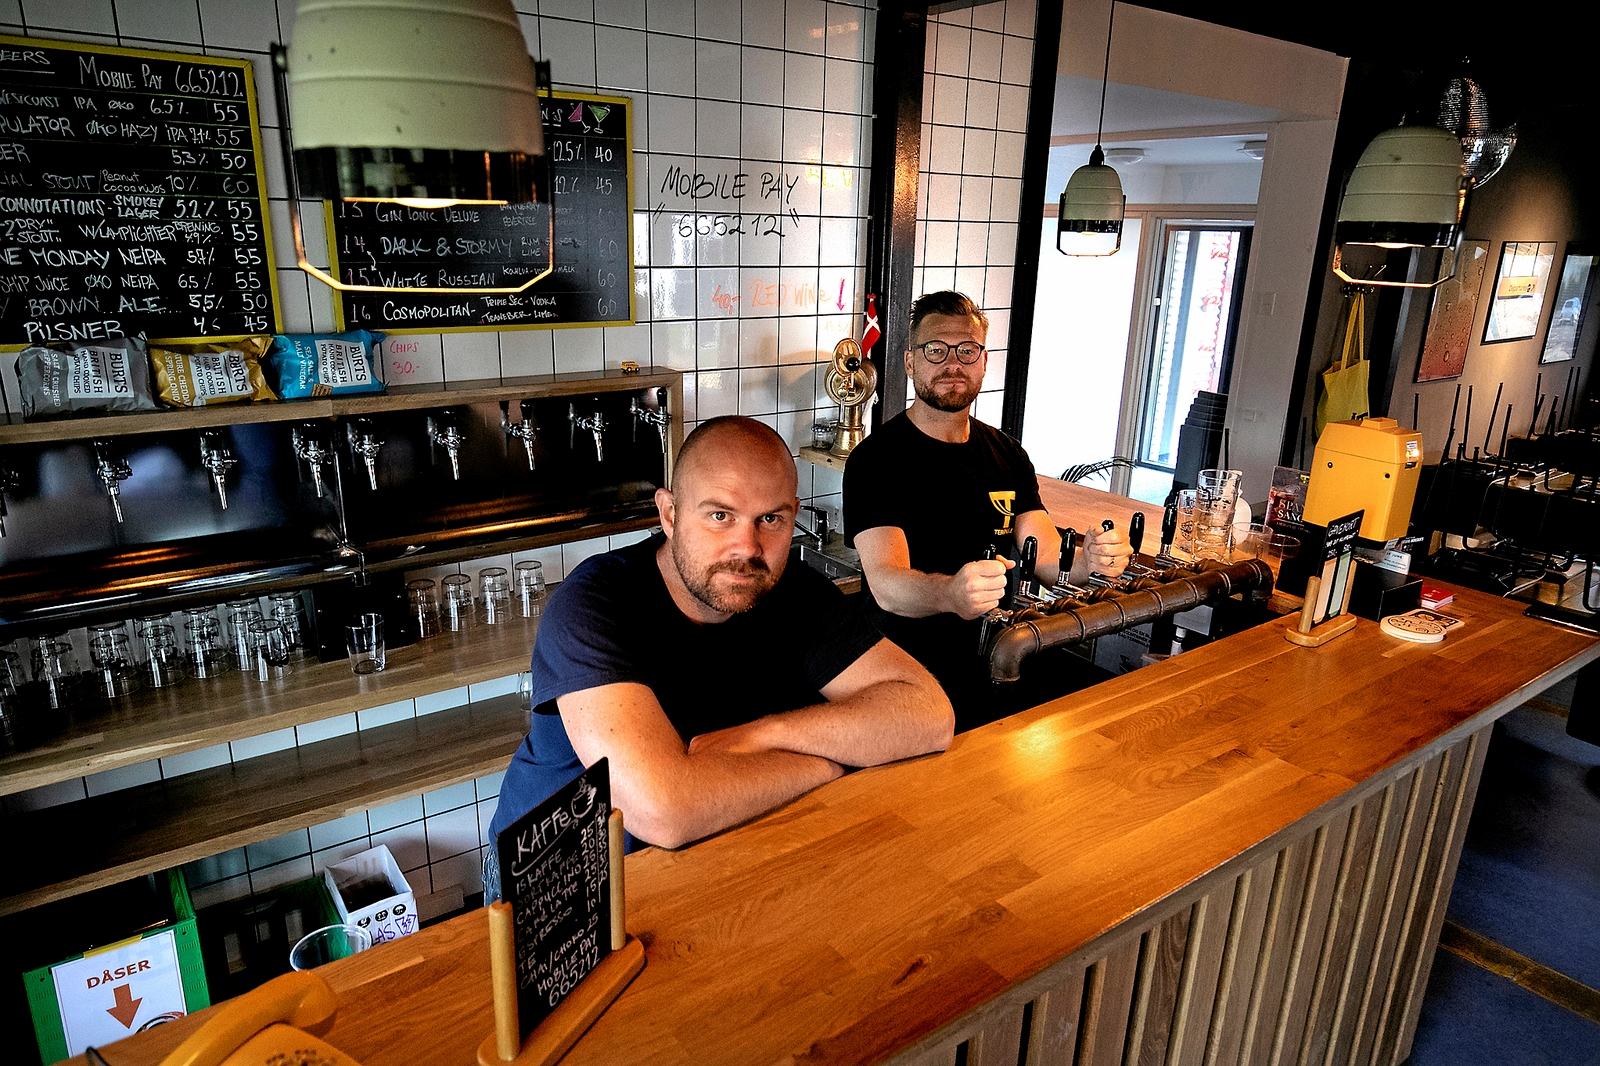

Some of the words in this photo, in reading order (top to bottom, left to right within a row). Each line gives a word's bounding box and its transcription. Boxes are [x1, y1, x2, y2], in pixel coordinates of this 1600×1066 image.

[0, 49, 51, 66] EERS
[174, 65, 244, 98] 665212
[73, 96, 98, 111] IPA
[213, 103, 239, 122] 55
[120, 122, 158, 143] HAZY
[216, 128, 246, 146] 55
[221, 152, 248, 170] 50
[594, 146, 613, 163] 40
[42, 171, 96, 191] STOUT
[223, 176, 251, 195] 60
[595, 176, 613, 196] 45
[660, 164, 749, 201] MOBILE
[760, 172, 800, 205] PAY
[112, 194, 166, 208] SMOKEY
[227, 200, 253, 220] 55
[117, 206, 160, 220] LAGER
[231, 222, 259, 243] 55
[342, 234, 366, 255] 14
[380, 235, 432, 258] DARK
[436, 236, 452, 257] &
[455, 236, 513, 258] STORMY
[28, 247, 110, 270] MONDAY
[234, 247, 262, 266] 55
[235, 271, 262, 290] 55
[345, 267, 371, 287] 15
[378, 270, 430, 289] WHITE
[437, 267, 496, 287] RUSSIAN
[242, 293, 268, 312] 50
[529, 295, 557, 307] VODKA
[749, 279, 788, 308] RED
[28, 296, 103, 318] BROWN
[350, 303, 371, 324] 16
[597, 297, 617, 317] 60
[243, 315, 268, 333] 45
[389, 340, 419, 354] CHIPS
[89, 350, 105, 394] BRITISH
[110, 352, 129, 394] BURTS
[229, 354, 249, 393] BURTS
[335, 344, 348, 383] BRITISH
[350, 345, 368, 382] BURTS
[211, 357, 228, 394] BRITISH
[85, 959, 152, 989] DÅSER
